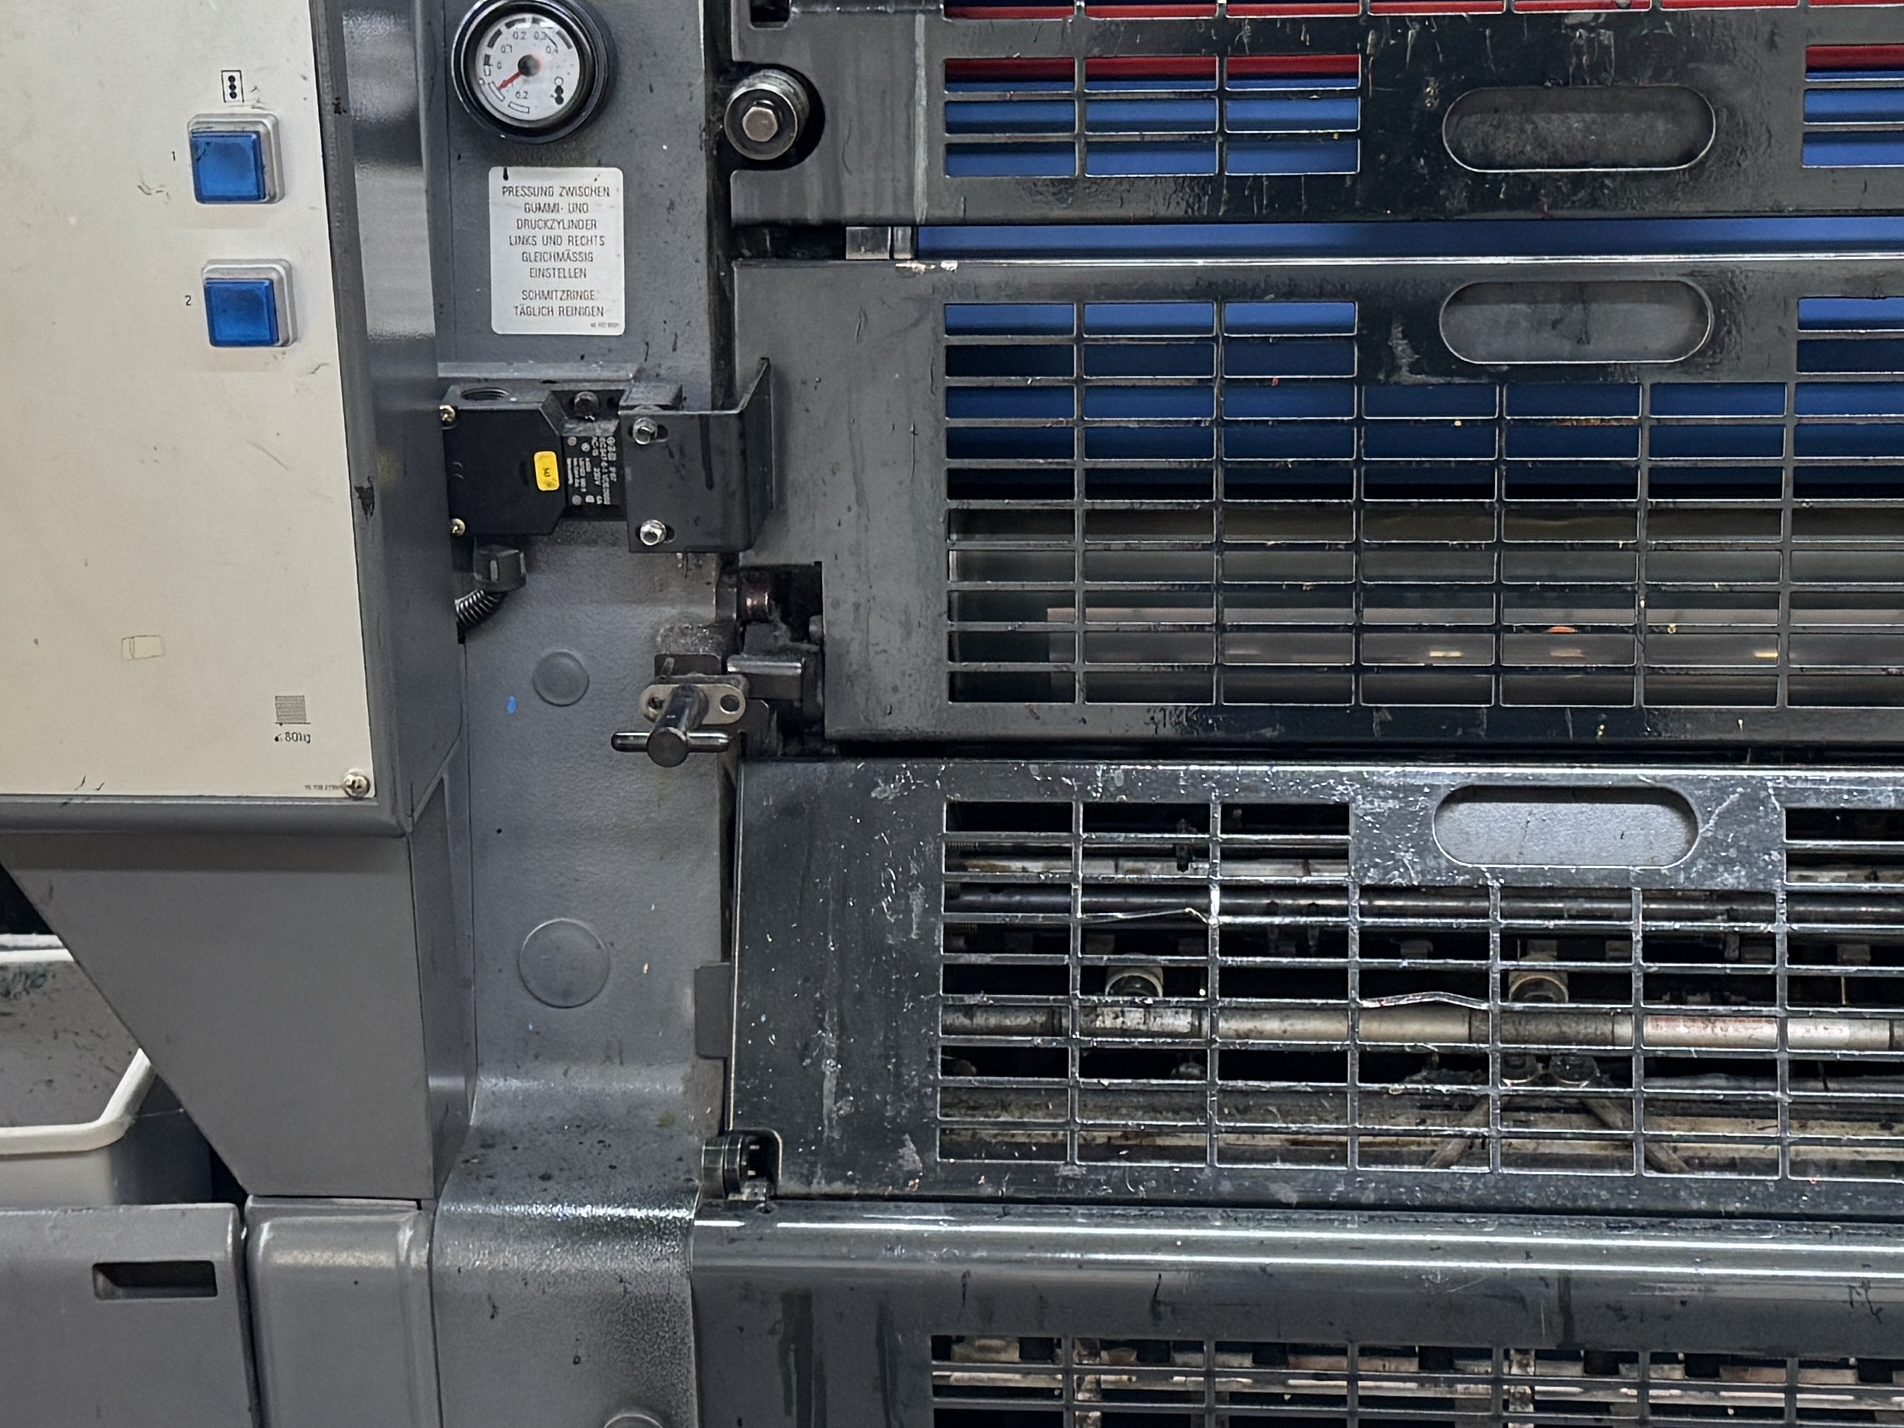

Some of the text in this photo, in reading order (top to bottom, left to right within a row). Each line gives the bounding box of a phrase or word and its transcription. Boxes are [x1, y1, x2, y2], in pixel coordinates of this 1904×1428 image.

[501, 185, 611, 198] PRESSUNG ZWISCHEN
[568, 202, 589, 214] UND
[516, 218, 598, 230] DRUCKZYLINDER
[508, 234, 606, 246] LINKS UND RECHTS
[521, 249, 594, 263] GLEICHMÄSSIG
[529, 267, 588, 279] EINSTELLEN
[184, 294, 192, 307] 2
[521, 289, 596, 301] SCHMITZRINGE
[514, 303, 604, 317] TÄGLICH REINIGEN
